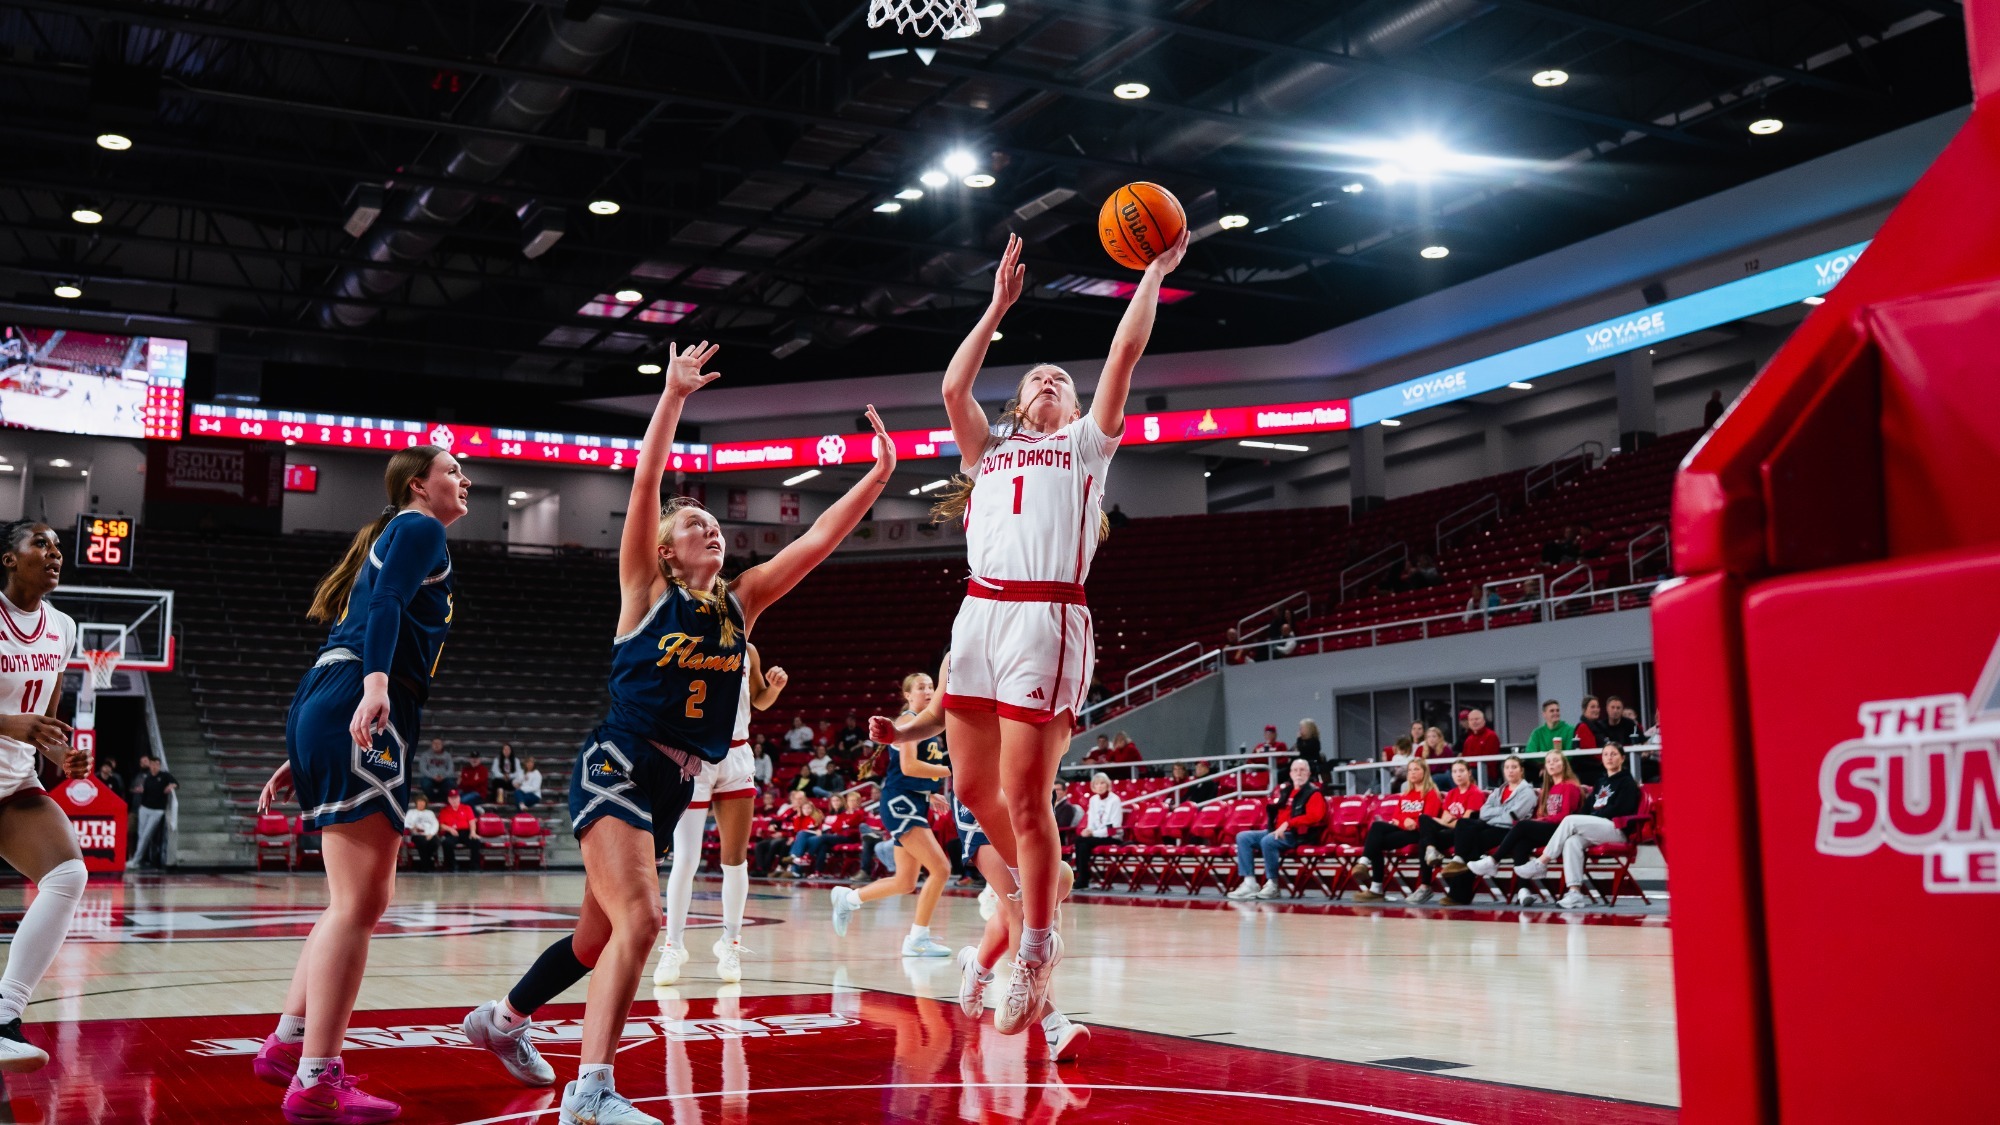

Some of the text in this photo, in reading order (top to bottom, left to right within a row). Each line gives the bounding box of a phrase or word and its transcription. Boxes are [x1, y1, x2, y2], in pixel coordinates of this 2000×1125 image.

[1121, 201, 1157, 260] Wilson
[1585, 311, 1664, 346] VOYAGE
[1402, 371, 1466, 400] VOYAGE
[199, 419, 221, 432] 3-4
[240, 422, 262, 435] 0-0
[281, 425, 303, 439] 0-0
[320, 428, 331, 441] 2
[342, 429, 352, 443] 3
[364, 431, 371, 444] 1
[384, 433, 391, 446] 1
[1144, 416, 1160, 441] 5
[176, 453, 244, 470] SOUTH
[578, 449, 599, 461] 0-0
[1017, 449, 1071, 470] DAKOTA
[175, 466, 244, 482] DAKOTA
[1012, 475, 1024, 514] 1
[92, 519, 128, 537] 6:58
[87, 535, 121, 563] 26
[656, 632, 741, 672] Flames
[21, 679, 43, 713] 11
[685, 680, 707, 719] 2
[1863, 698, 1961, 739] THE
[366, 749, 398, 769] Flames
